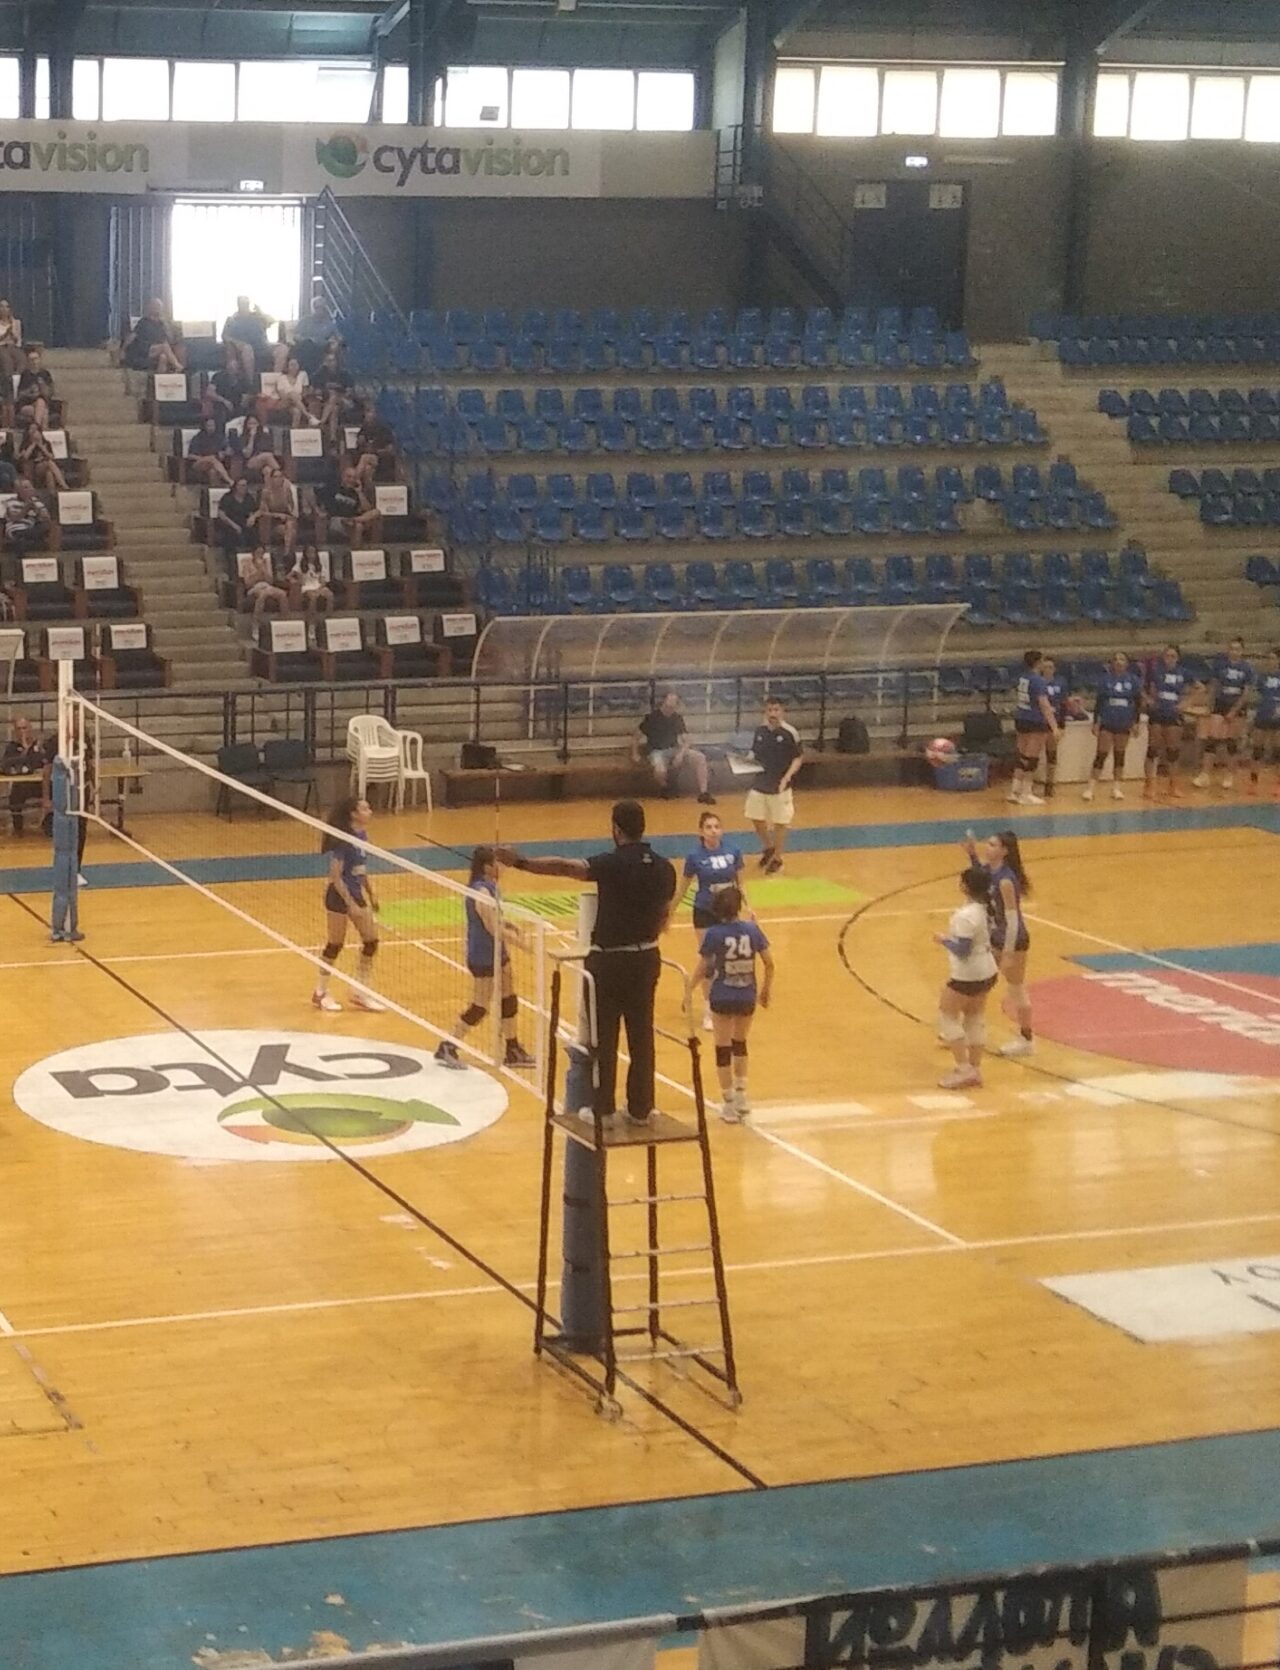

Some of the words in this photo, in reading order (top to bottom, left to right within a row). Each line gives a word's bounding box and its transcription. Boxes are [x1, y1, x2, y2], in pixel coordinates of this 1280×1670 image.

[373, 137, 570, 187] cytavision
[725, 935, 752, 960] 24
[48, 1043, 423, 1099] cyta
